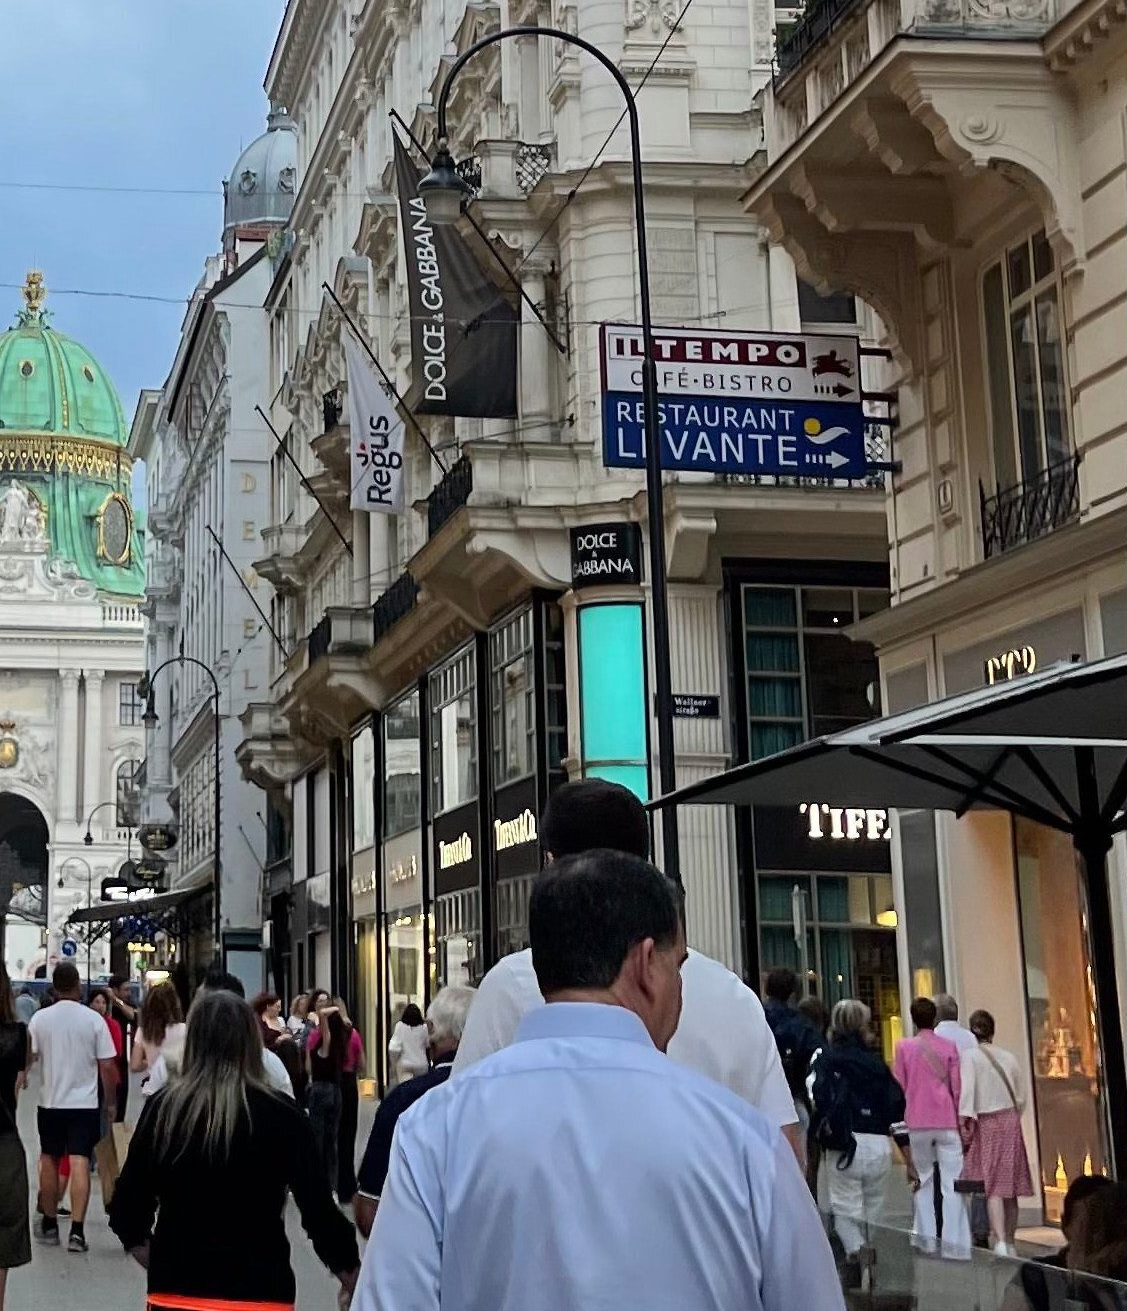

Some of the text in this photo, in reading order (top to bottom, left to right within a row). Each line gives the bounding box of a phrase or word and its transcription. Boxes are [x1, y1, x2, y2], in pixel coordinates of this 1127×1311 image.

[408, 197, 444, 311] GABBANA
[424, 322, 446, 401] DOLCE
[616, 338, 800, 364] IL TEMPO
[367, 415, 402, 505] Regus
[617, 427, 799, 467] LVANTE
[577, 533, 617, 551] DOLCE
[573, 558, 634, 578] GABBANA
